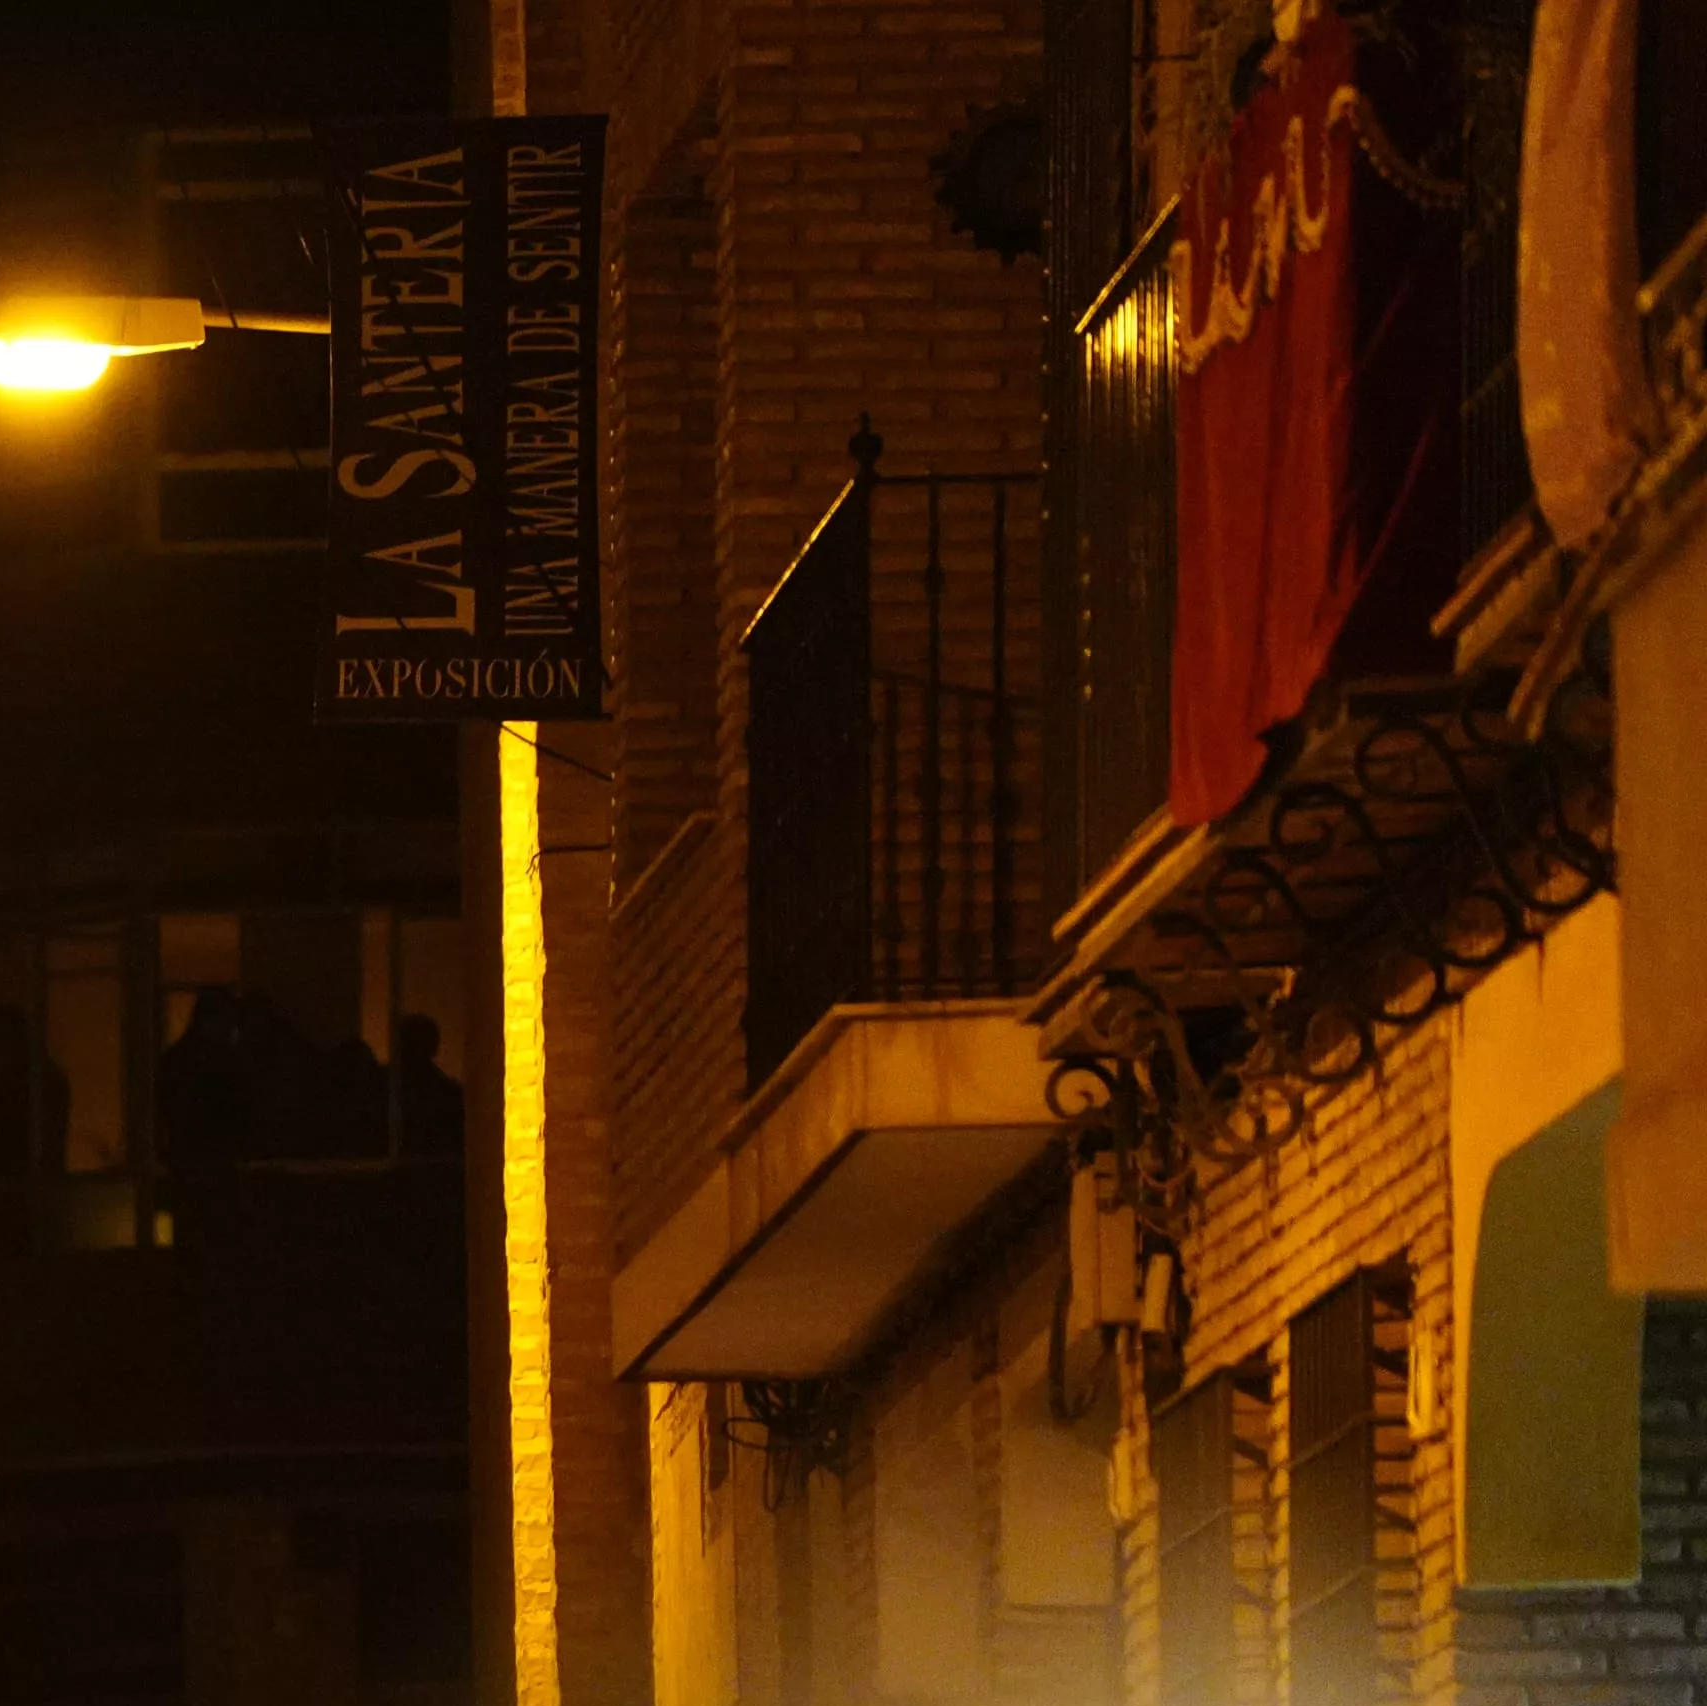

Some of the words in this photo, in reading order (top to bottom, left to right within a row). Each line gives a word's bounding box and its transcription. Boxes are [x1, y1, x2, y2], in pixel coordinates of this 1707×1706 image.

[506, 143, 585, 282] SENTIR
[506, 303, 581, 356] DE
[505, 368, 580, 539] MANERA
[336, 529, 476, 637] LA
[504, 555, 580, 637] UNA
[337, 648, 583, 700] EXPOSICIÓN
